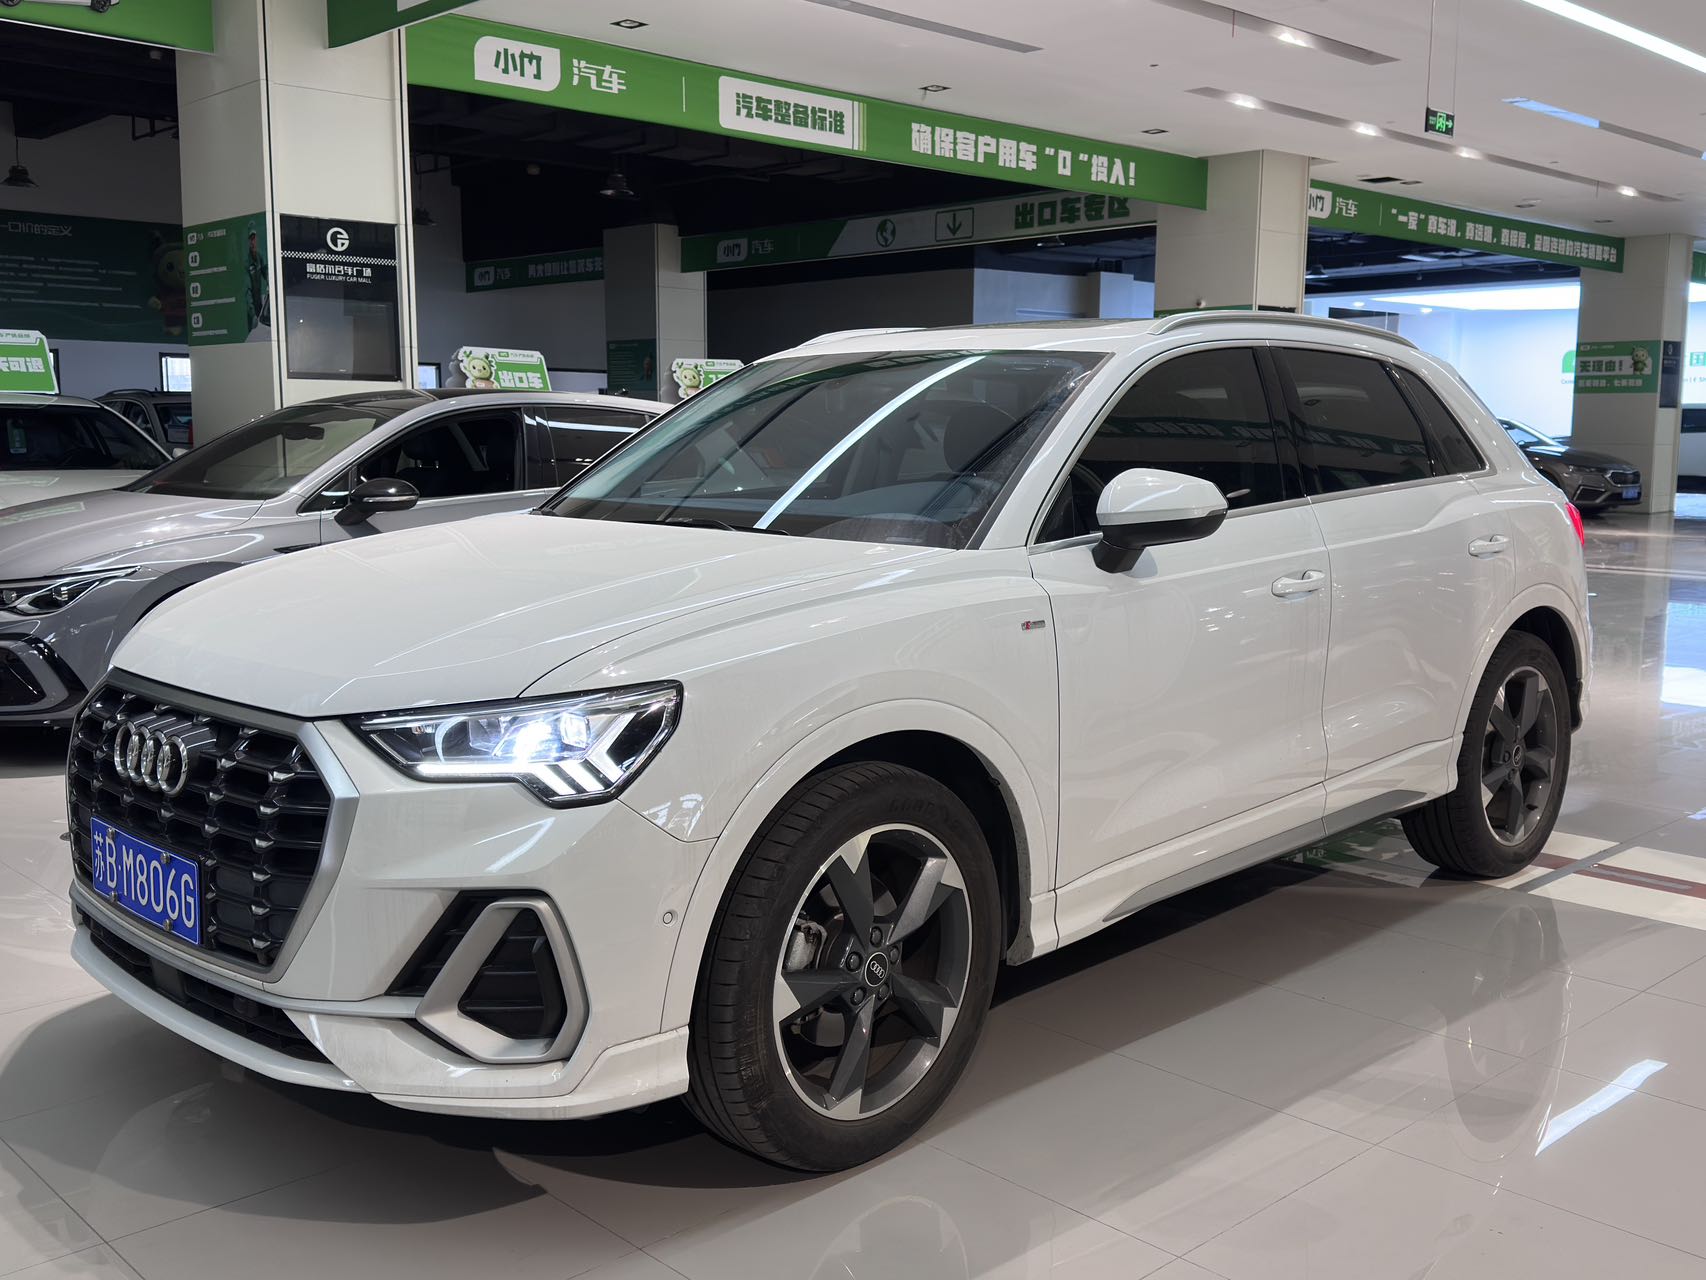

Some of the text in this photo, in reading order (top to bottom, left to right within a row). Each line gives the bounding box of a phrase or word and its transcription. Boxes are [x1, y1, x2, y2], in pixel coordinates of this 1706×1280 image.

[494, 48, 627, 94] 小竹 汽车
[735, 92, 845, 135] 汽车整备标准
[752, 240, 774, 254] 汽车
[1015, 194, 1130, 230] 出口车专区
[1335, 196, 1359, 218] 汽车
[498, 370, 544, 389] 出口车
